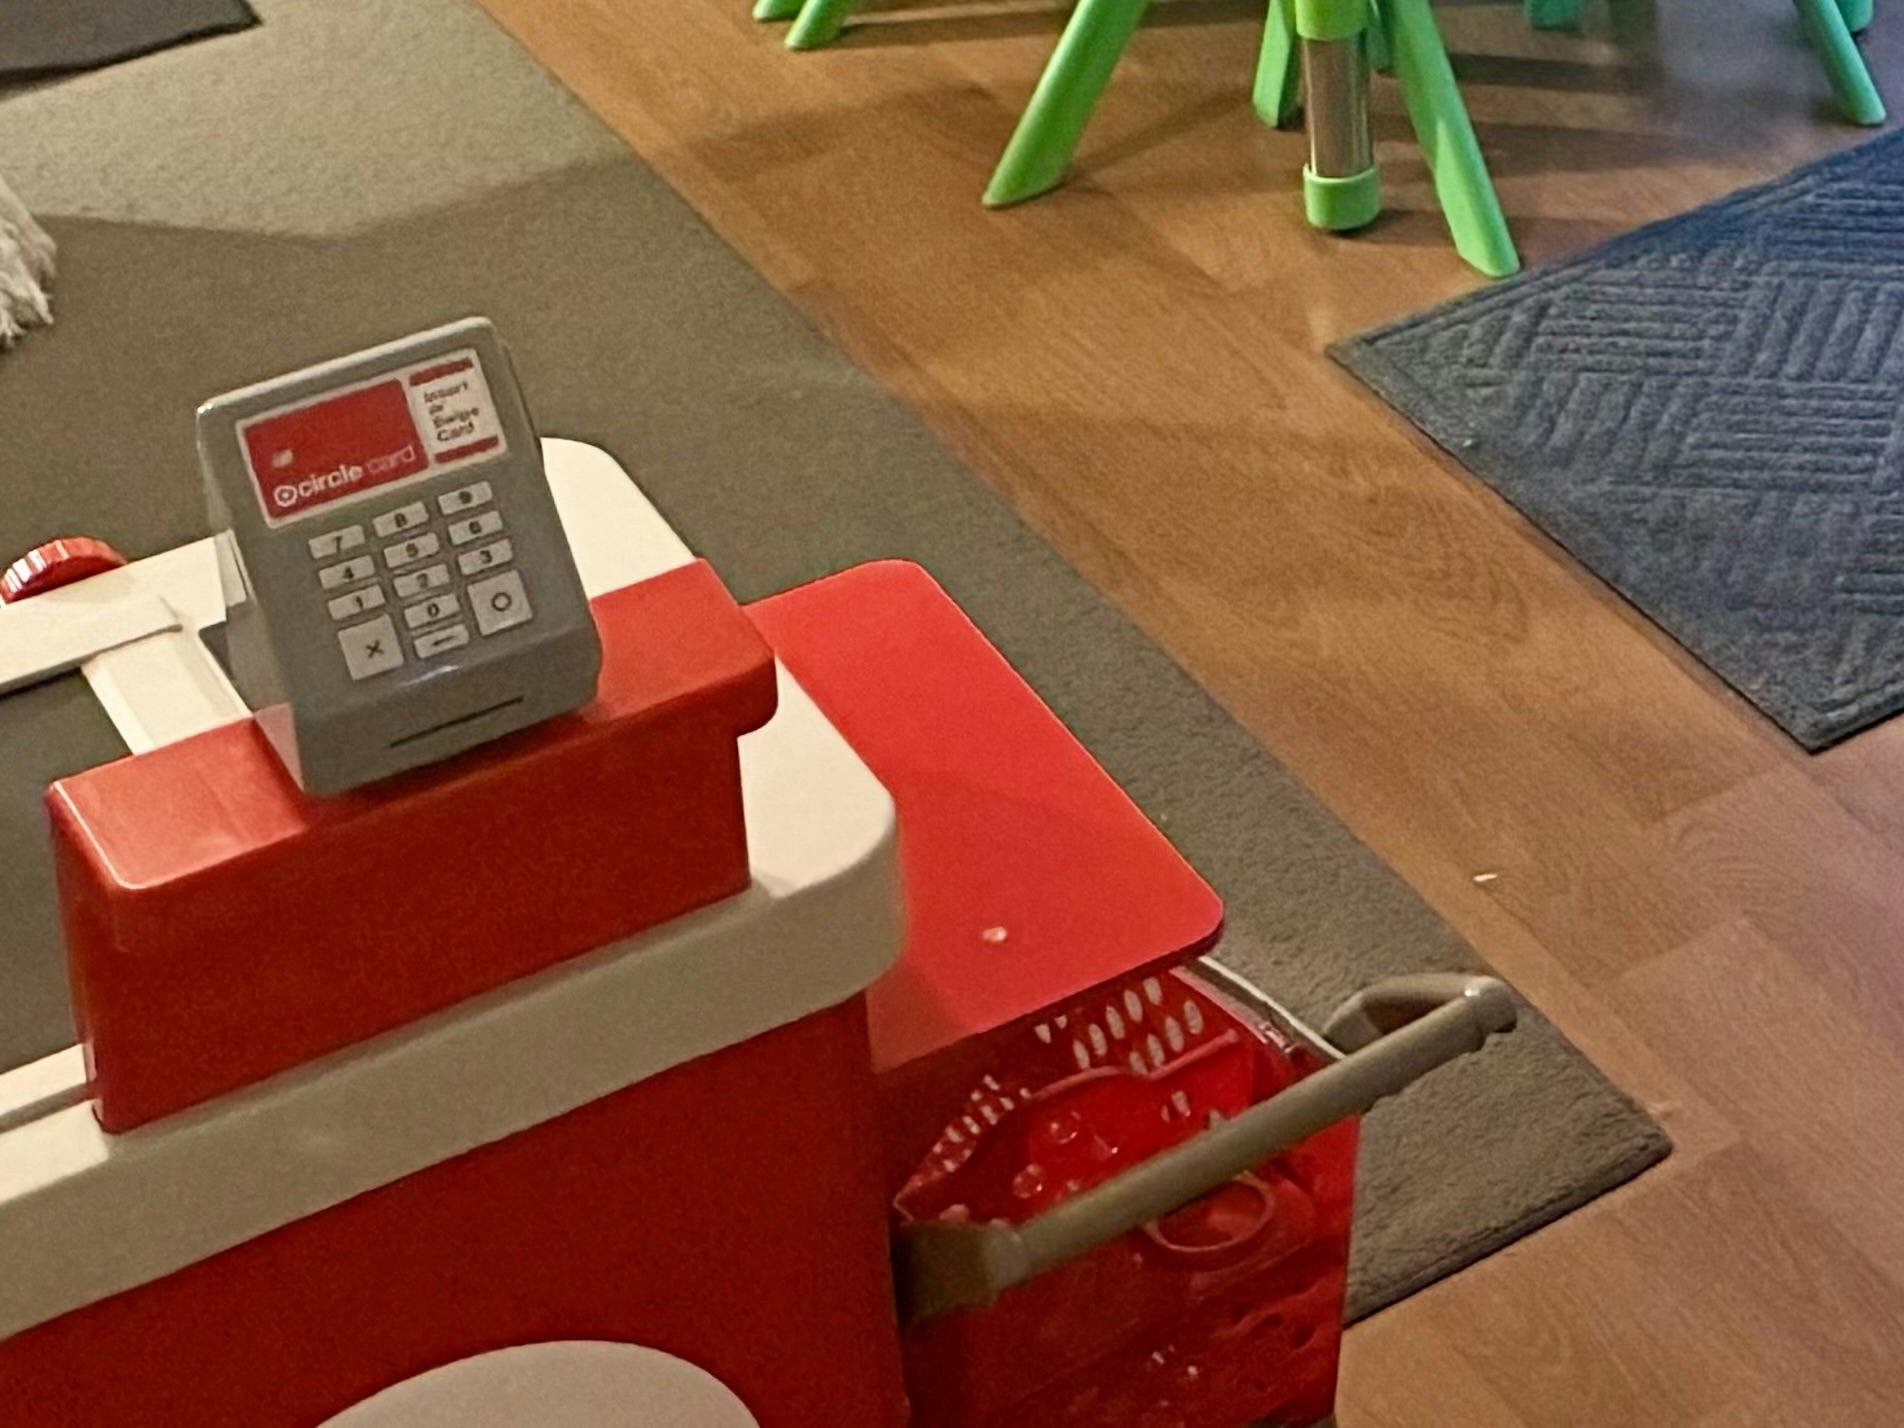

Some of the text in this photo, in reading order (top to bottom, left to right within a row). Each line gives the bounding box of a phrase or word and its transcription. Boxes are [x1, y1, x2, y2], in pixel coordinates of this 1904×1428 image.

[299, 444, 417, 499] circle card
[333, 535, 344, 553] 7
